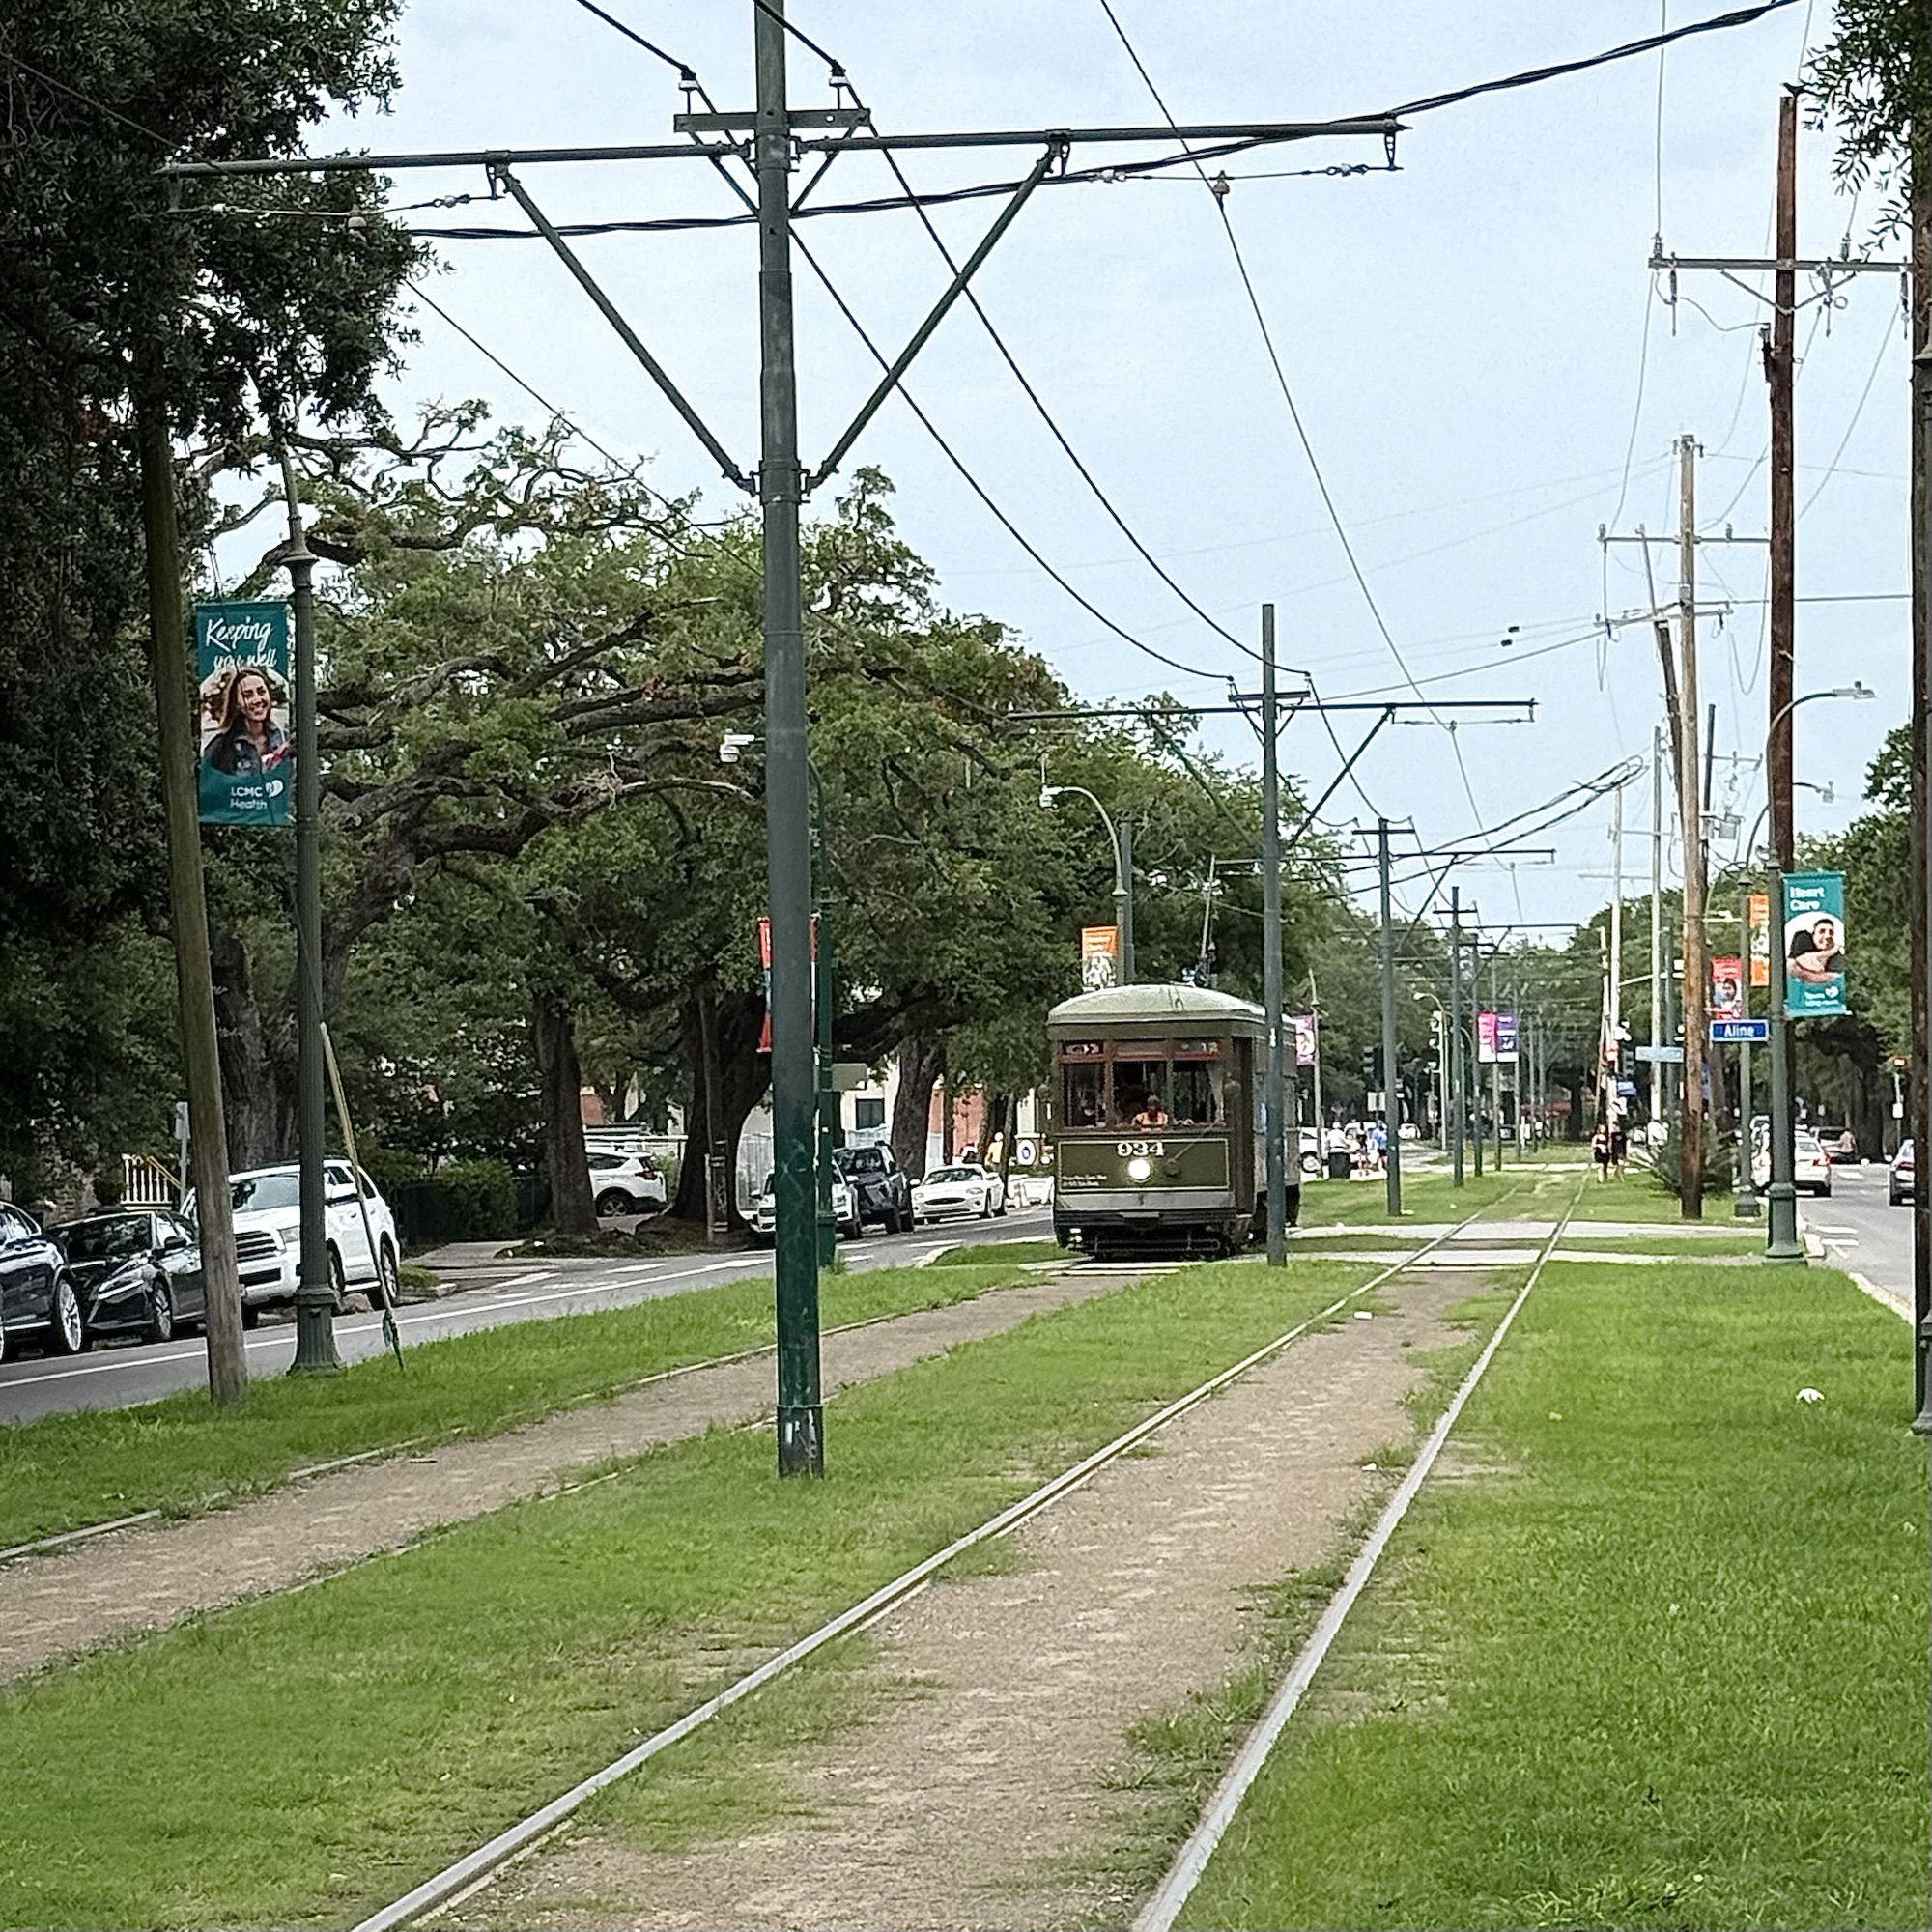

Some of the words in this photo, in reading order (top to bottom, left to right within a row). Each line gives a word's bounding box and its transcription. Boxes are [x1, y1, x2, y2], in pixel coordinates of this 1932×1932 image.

[205, 615, 274, 653] Keeping
[246, 648, 278, 668] well
[231, 786, 263, 798] LCMC
[230, 798, 268, 810] Health
[1789, 886, 1825, 898] Heart
[1789, 899, 1821, 911] Care
[1723, 1024, 1755, 1037] Aline
[1116, 1141, 1165, 1157] 934
